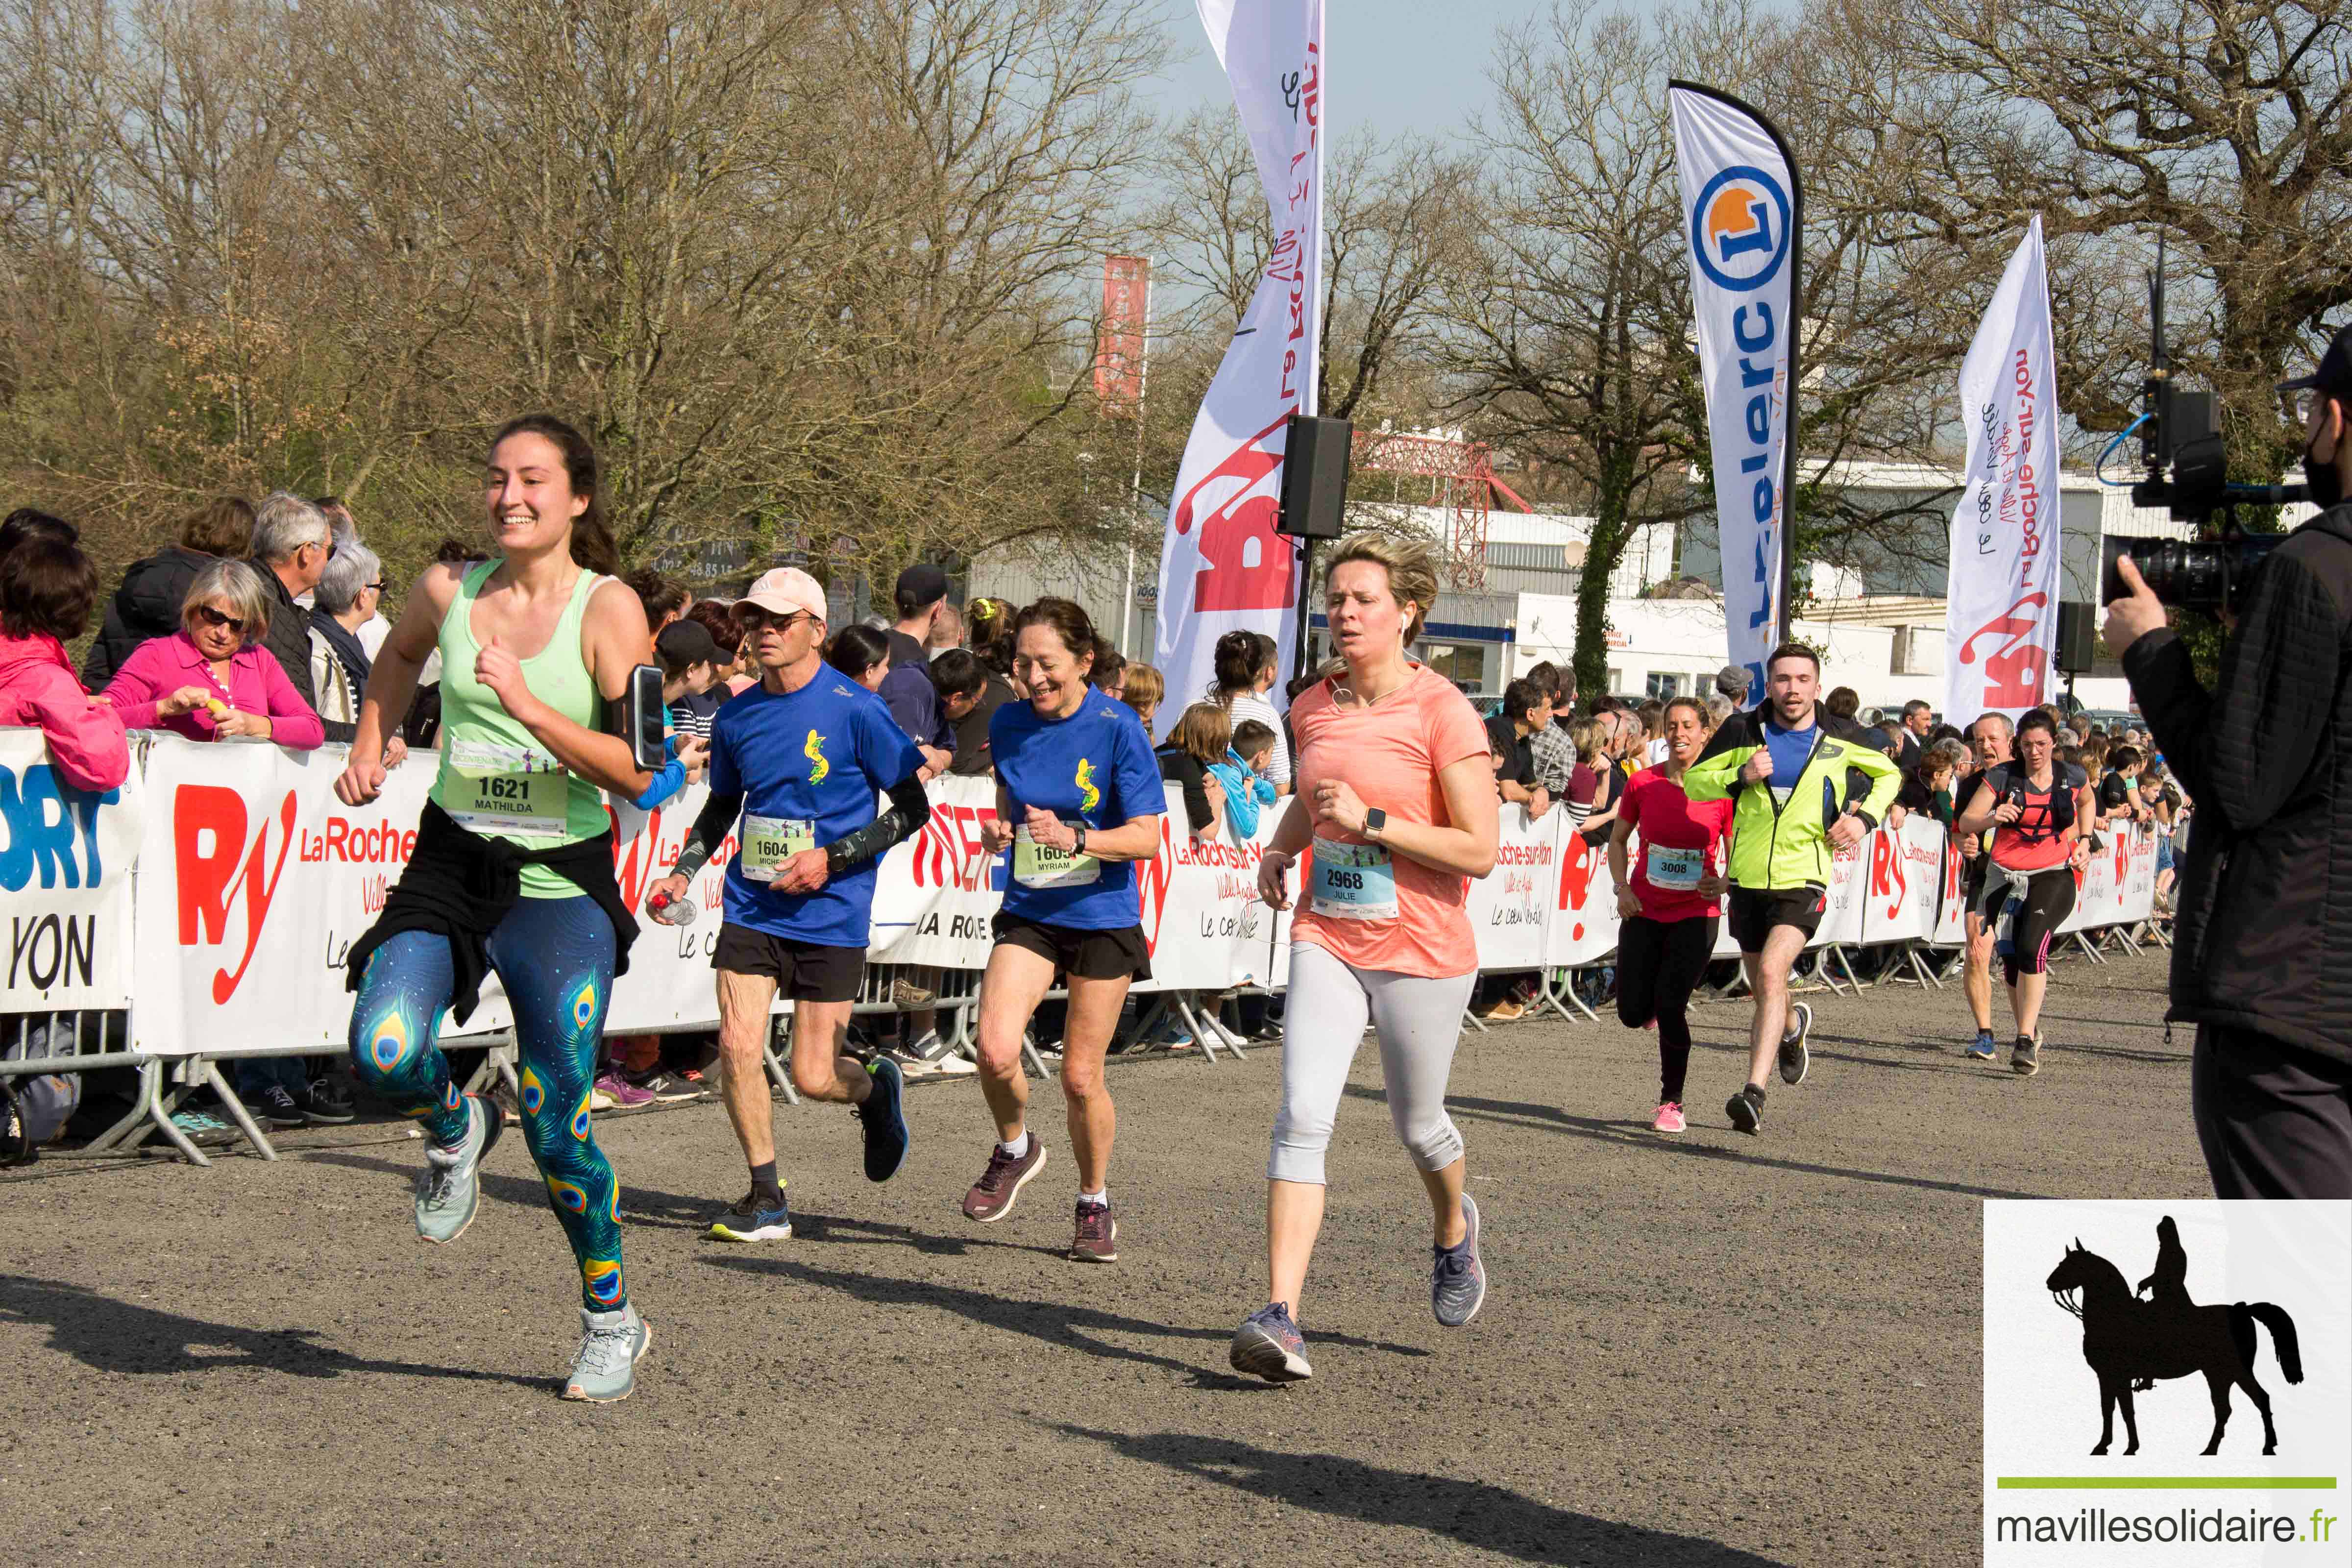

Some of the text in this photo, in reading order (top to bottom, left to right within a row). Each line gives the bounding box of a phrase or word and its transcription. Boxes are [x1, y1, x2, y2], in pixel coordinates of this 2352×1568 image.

[478, 777, 530, 800] 1621
[475, 799, 534, 813] MATHILDA
[757, 840, 788, 857] 1604
[1038, 862, 1070, 871] MYRIAM
[1661, 862, 1687, 874] 3008
[1327, 869, 1364, 889] 2968
[1333, 890, 1357, 901] JULIE
[915, 912, 939, 936] LA
[1201, 911, 1214, 938] Le
[7, 913, 96, 991] YON
